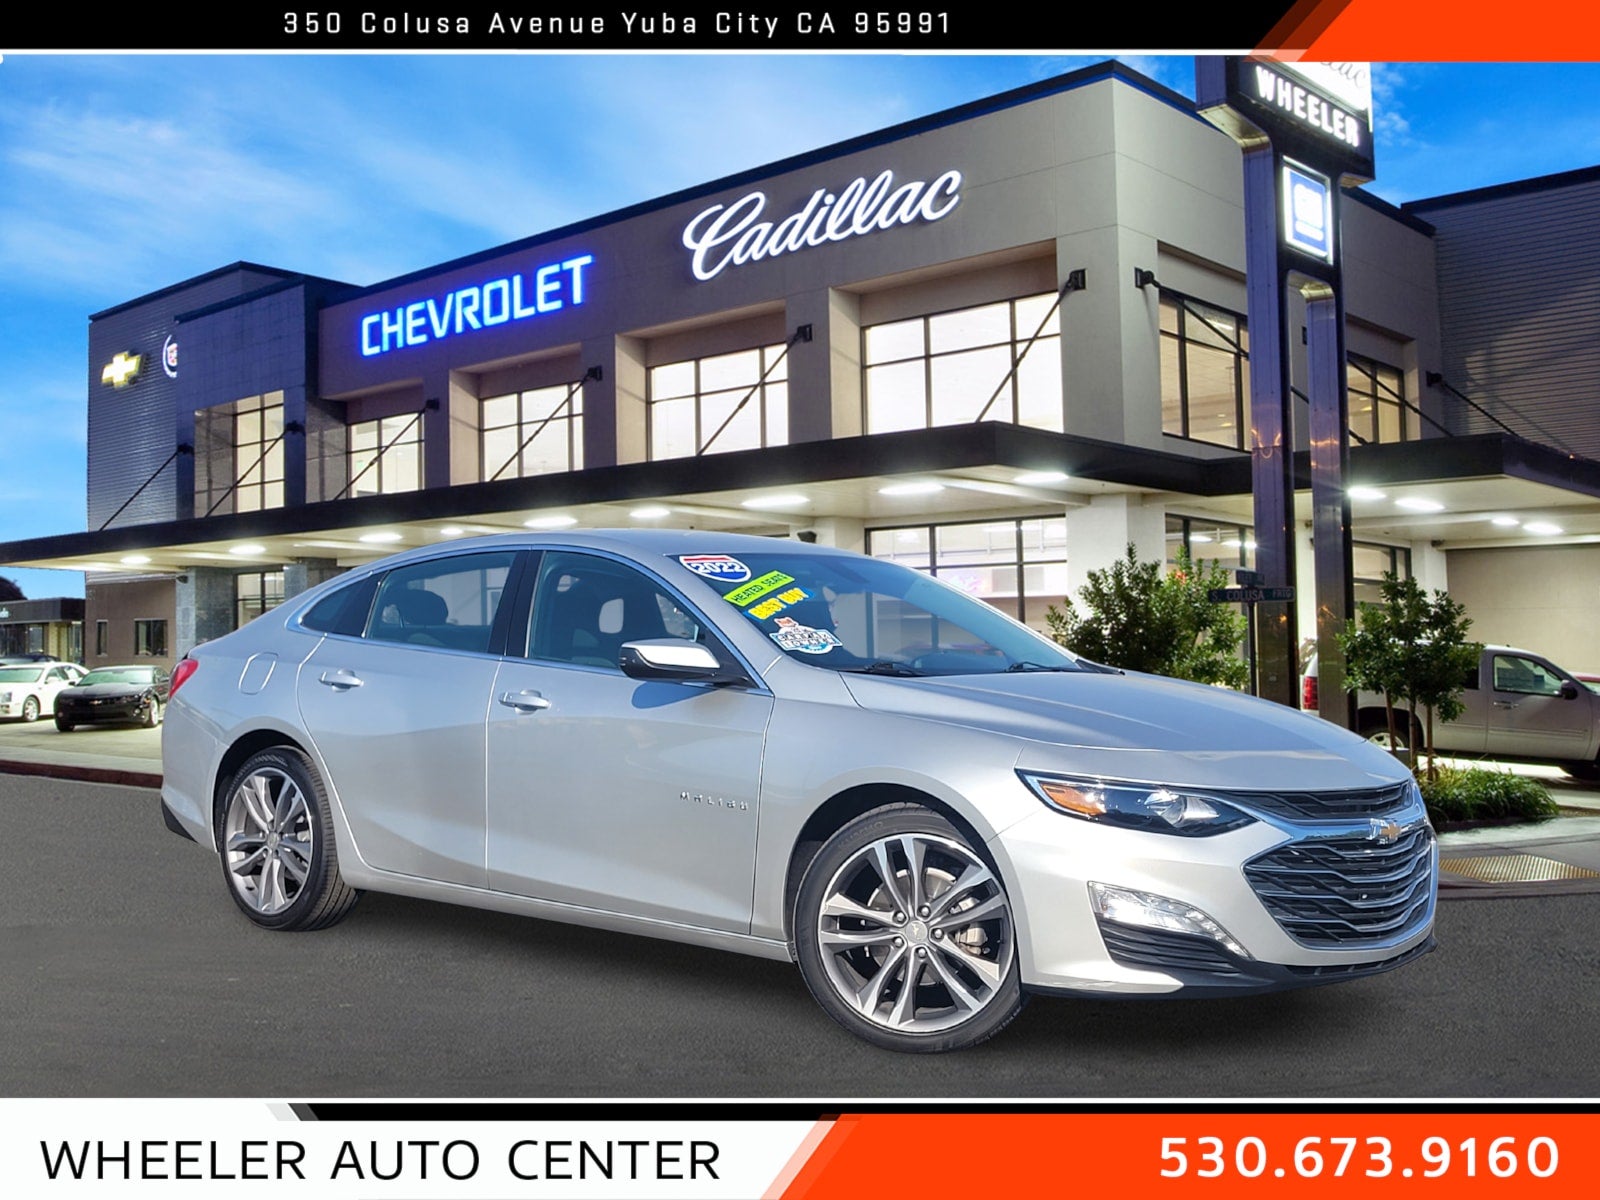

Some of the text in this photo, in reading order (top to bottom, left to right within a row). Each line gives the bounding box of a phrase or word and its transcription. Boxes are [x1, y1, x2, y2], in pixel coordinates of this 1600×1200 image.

[1255, 65, 1359, 148] WHEELER
[683, 169, 962, 281] Cadillac
[361, 253, 593, 357] CHEVROLET
[731, 574, 788, 602] HEATED SEATS
[1211, 590, 1219, 601] S
[1226, 588, 1265, 601] COLUSA
